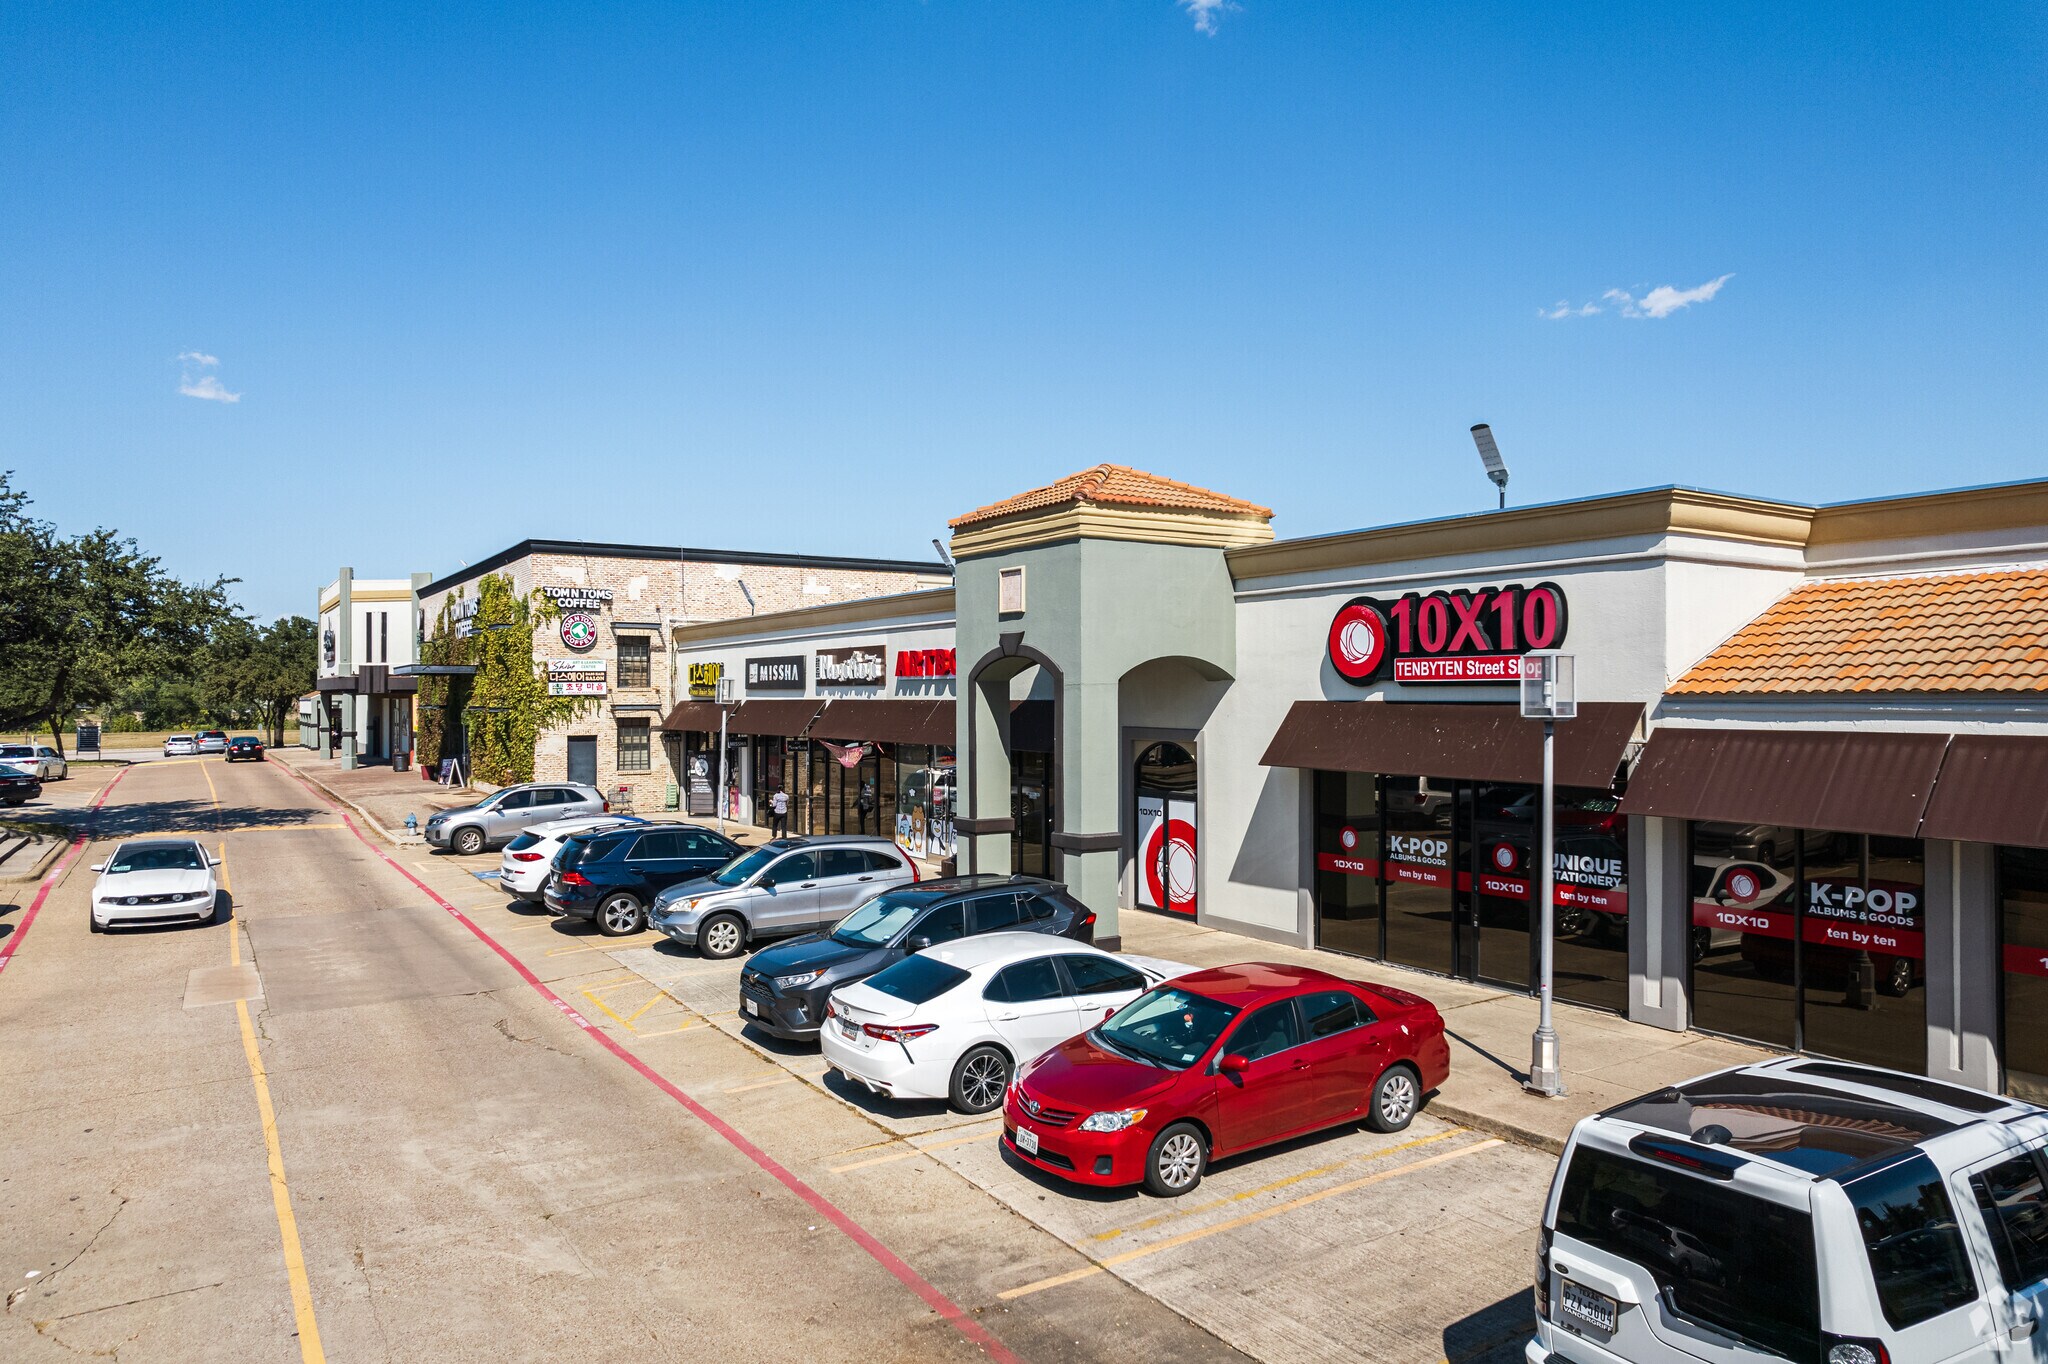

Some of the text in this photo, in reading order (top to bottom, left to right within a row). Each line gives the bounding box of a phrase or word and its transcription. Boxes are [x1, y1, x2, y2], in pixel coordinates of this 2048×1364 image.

[544, 587, 613, 600] TOM N TOMS
[557, 598, 600, 609] COFFEE
[564, 617, 575, 632] TOM
[580, 616, 595, 633] TOMS
[1391, 588, 1557, 653] 10X10
[565, 634, 593, 646] COFFEE
[760, 664, 798, 681] MISSHA
[1397, 661, 1463, 676] TENBYTEN
[1466, 659, 1505, 676] Street
[550, 671, 585, 682] 다스헤어
[1139, 808, 1162, 817] 10X10
[1391, 835, 1448, 857] K-POP
[1334, 859, 1364, 871] 10X10
[1390, 853, 1416, 863] ALBUMS
[1422, 857, 1447, 866] GOODS
[1399, 869, 1437, 881] ten by ten
[1552, 870, 1622, 888] TATIONERY
[1485, 880, 1524, 894] 10X10
[1560, 890, 1608, 905] ten by ten
[1810, 882, 1917, 915] K-POP
[1716, 912, 1769, 929] 10X10
[1808, 905, 1914, 927] ALBUMS & GOODS
[1827, 928, 1897, 947] ten by ten
[1580, 1288, 1600, 1302] TEXAS
[1563, 1305, 1613, 1332] VANDERGRIFF
